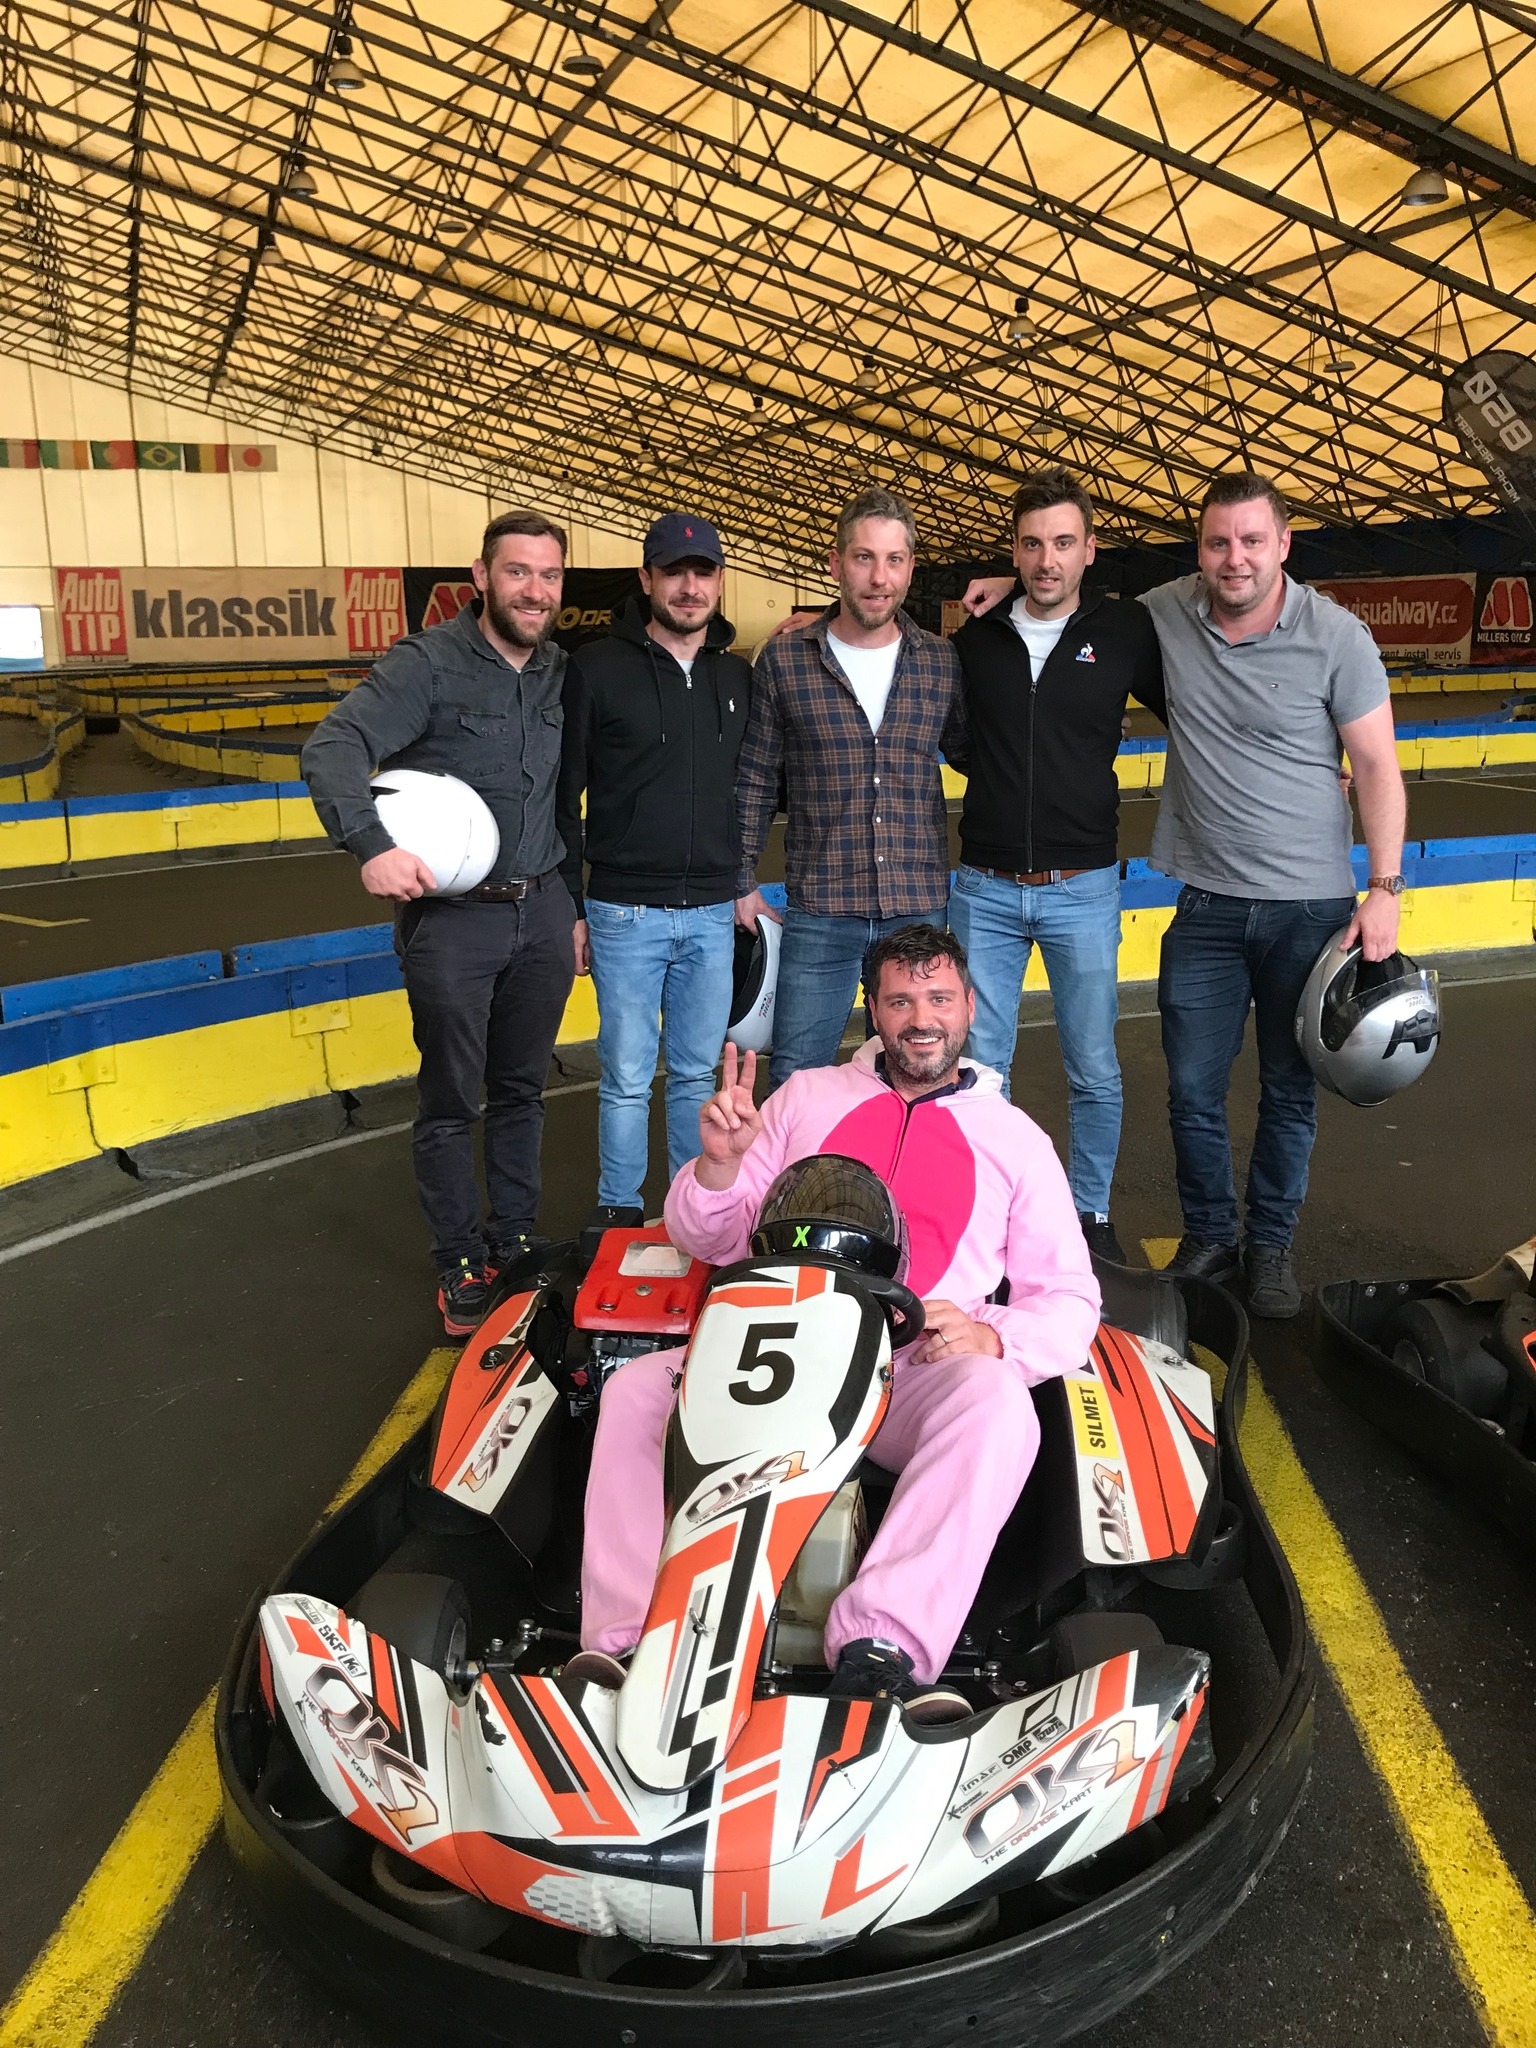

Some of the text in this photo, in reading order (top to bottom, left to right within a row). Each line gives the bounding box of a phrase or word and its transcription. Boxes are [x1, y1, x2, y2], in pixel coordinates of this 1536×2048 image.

[60, 571, 120, 613] Auto
[346, 571, 400, 611] Auto
[65, 613, 121, 652] TIP
[132, 588, 337, 638] klassik
[350, 611, 400, 648] TIP
[1433, 647, 1462, 660] servis
[1477, 632, 1532, 643] MILLERS OILS
[791, 1225, 812, 1248] X
[728, 1321, 800, 1406] 5
[1080, 1386, 1107, 1449] SILMET
[318, 1624, 348, 1653] SKF
[301, 1690, 318, 1714] THE
[350, 1758, 375, 1789] KART
[1001, 1739, 1032, 1765] OMP
[981, 1786, 1092, 1866] THE ORANGE KART
